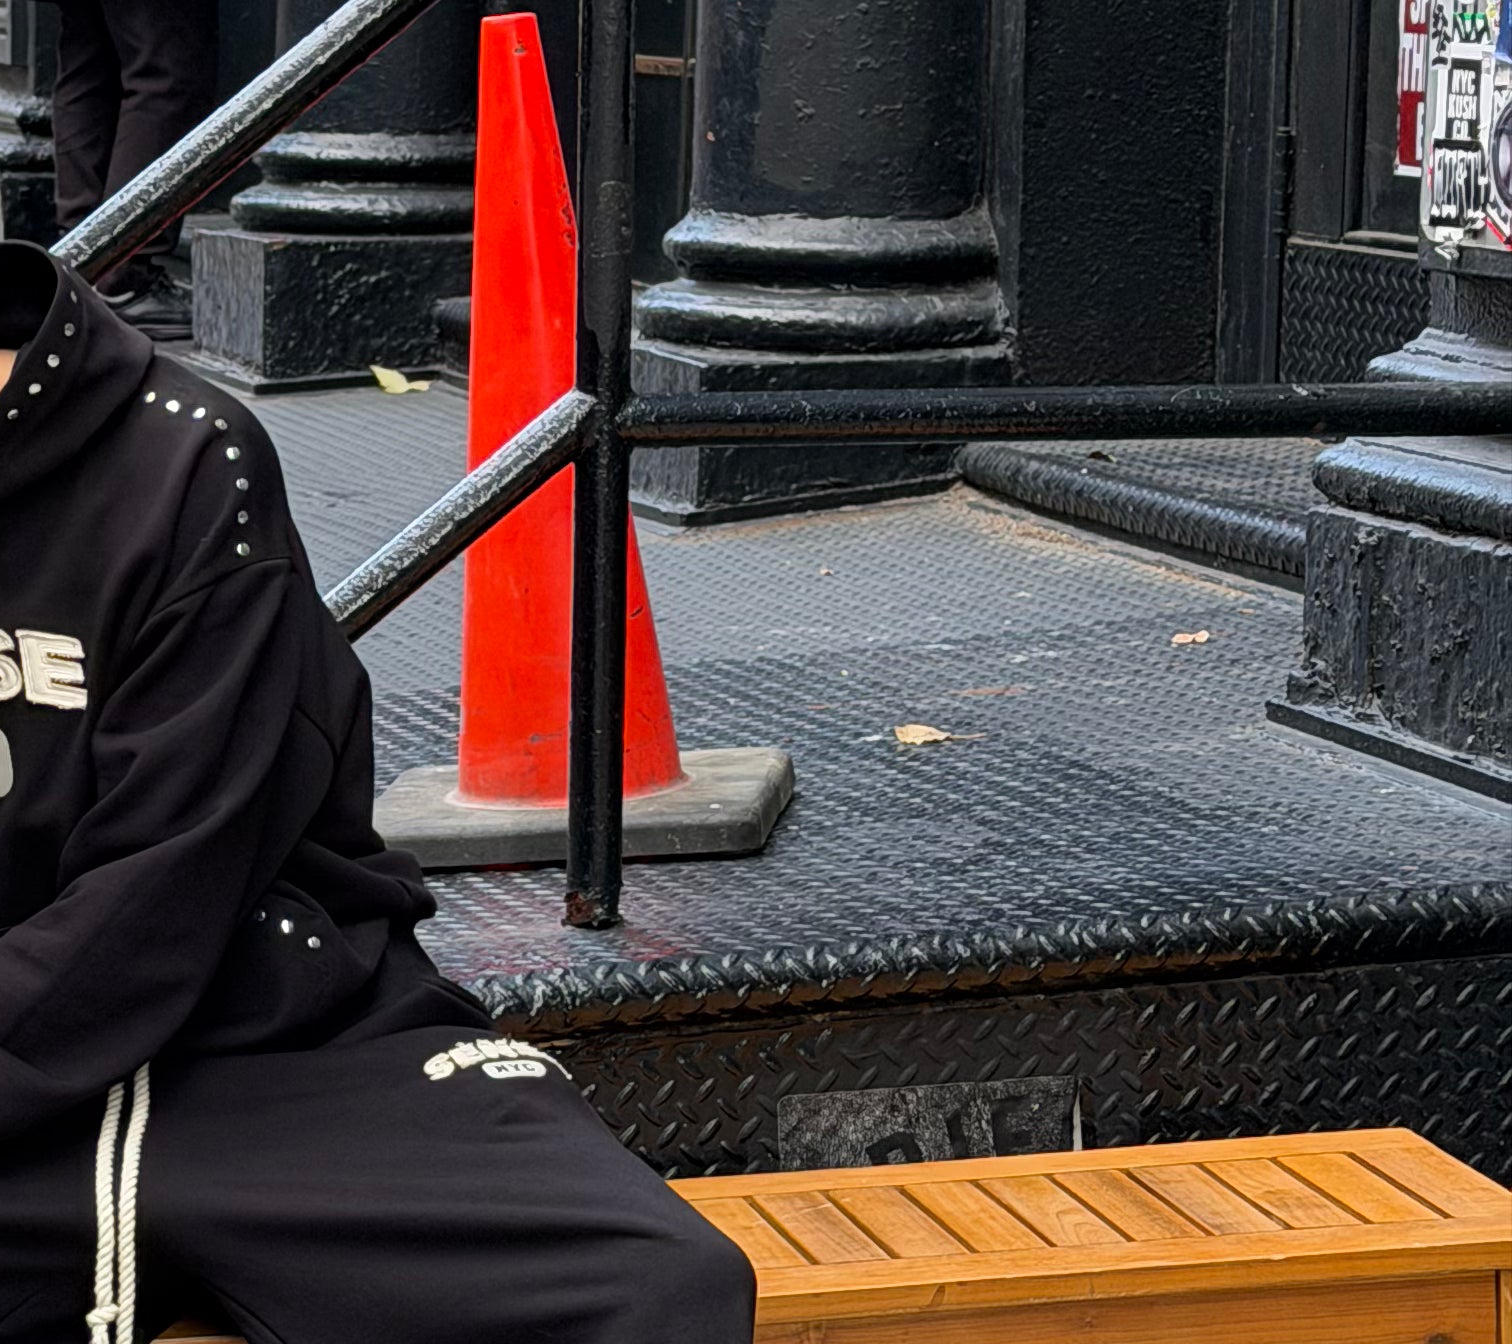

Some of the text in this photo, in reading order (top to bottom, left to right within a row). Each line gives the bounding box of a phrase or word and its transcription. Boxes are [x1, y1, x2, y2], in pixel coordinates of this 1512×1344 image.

[1451, 68, 1476, 95] NYC
[1447, 93, 1477, 120] KUSH
[494, 1063, 536, 1073] NYC
